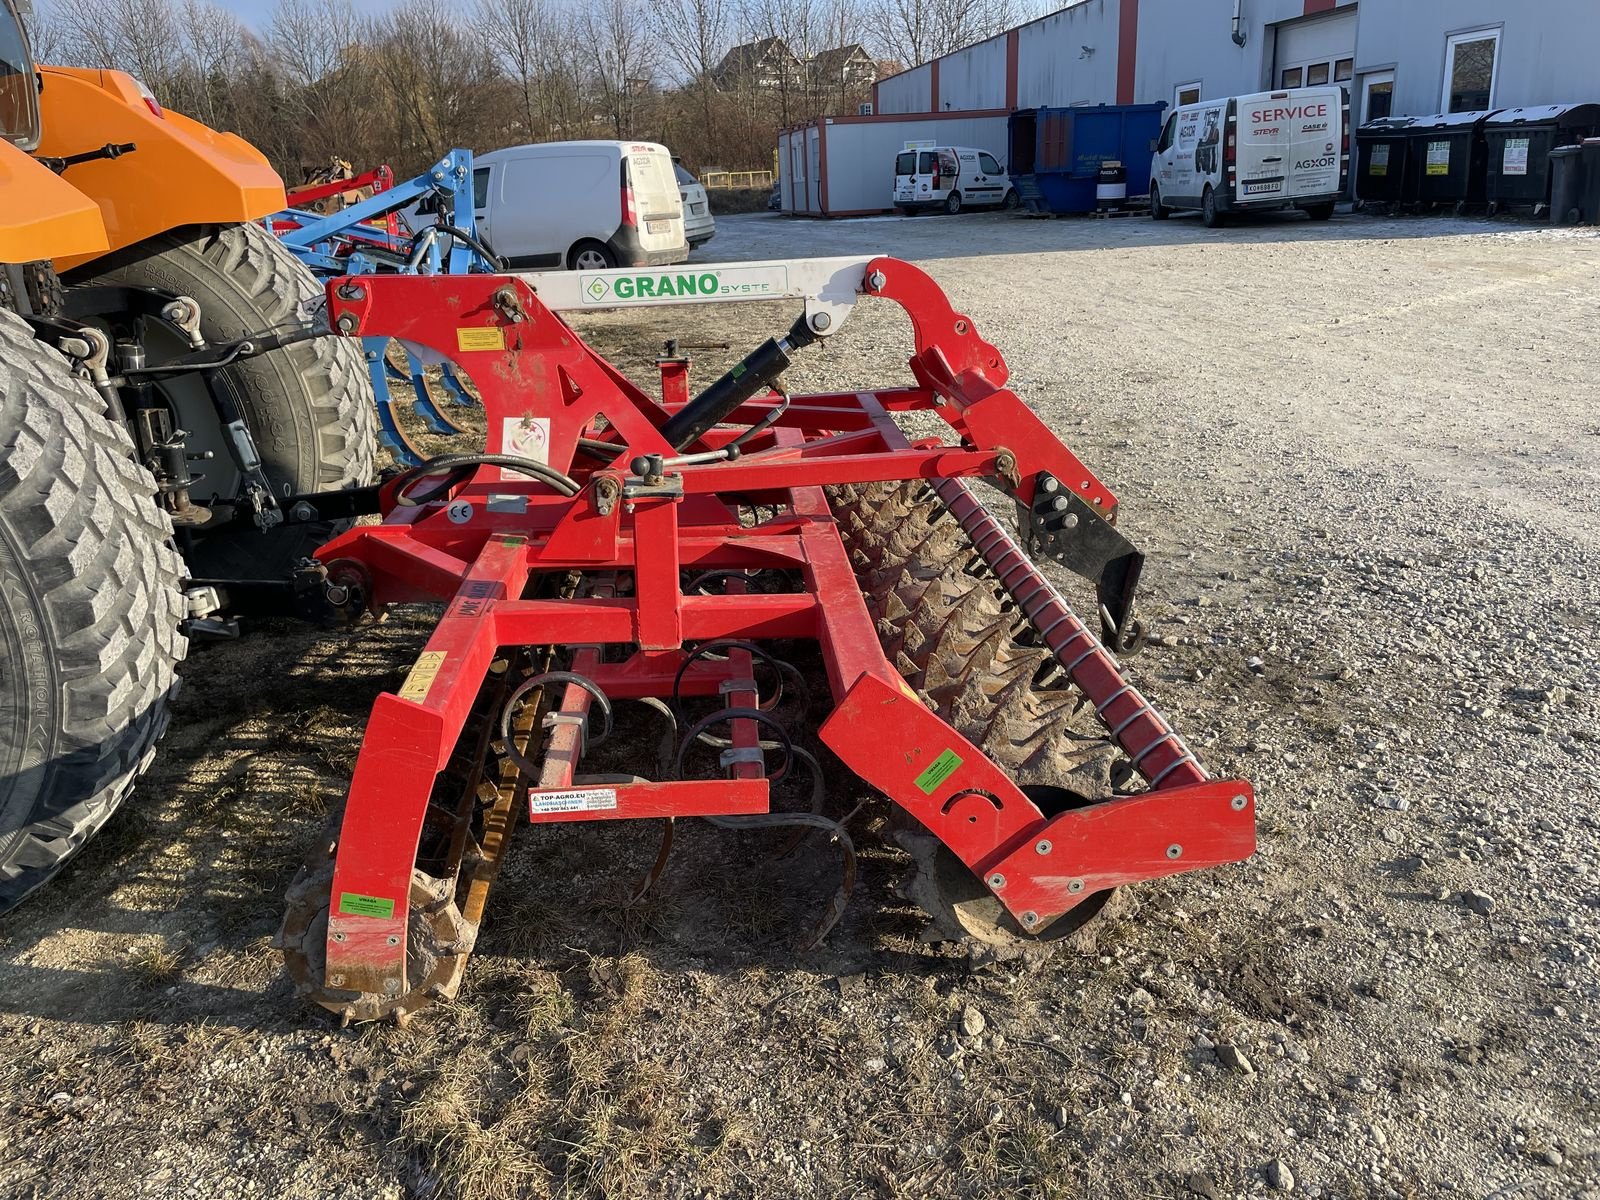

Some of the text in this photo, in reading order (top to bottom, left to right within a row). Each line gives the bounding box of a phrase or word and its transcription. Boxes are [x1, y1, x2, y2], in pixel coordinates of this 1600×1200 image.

[1251, 104, 1327, 124] SERVICE
[1253, 128, 1280, 136] STEYR
[1294, 157, 1336, 170] AGXOR
[613, 273, 719, 299] GRANO
[18, 608, 50, 718] ROTATION
